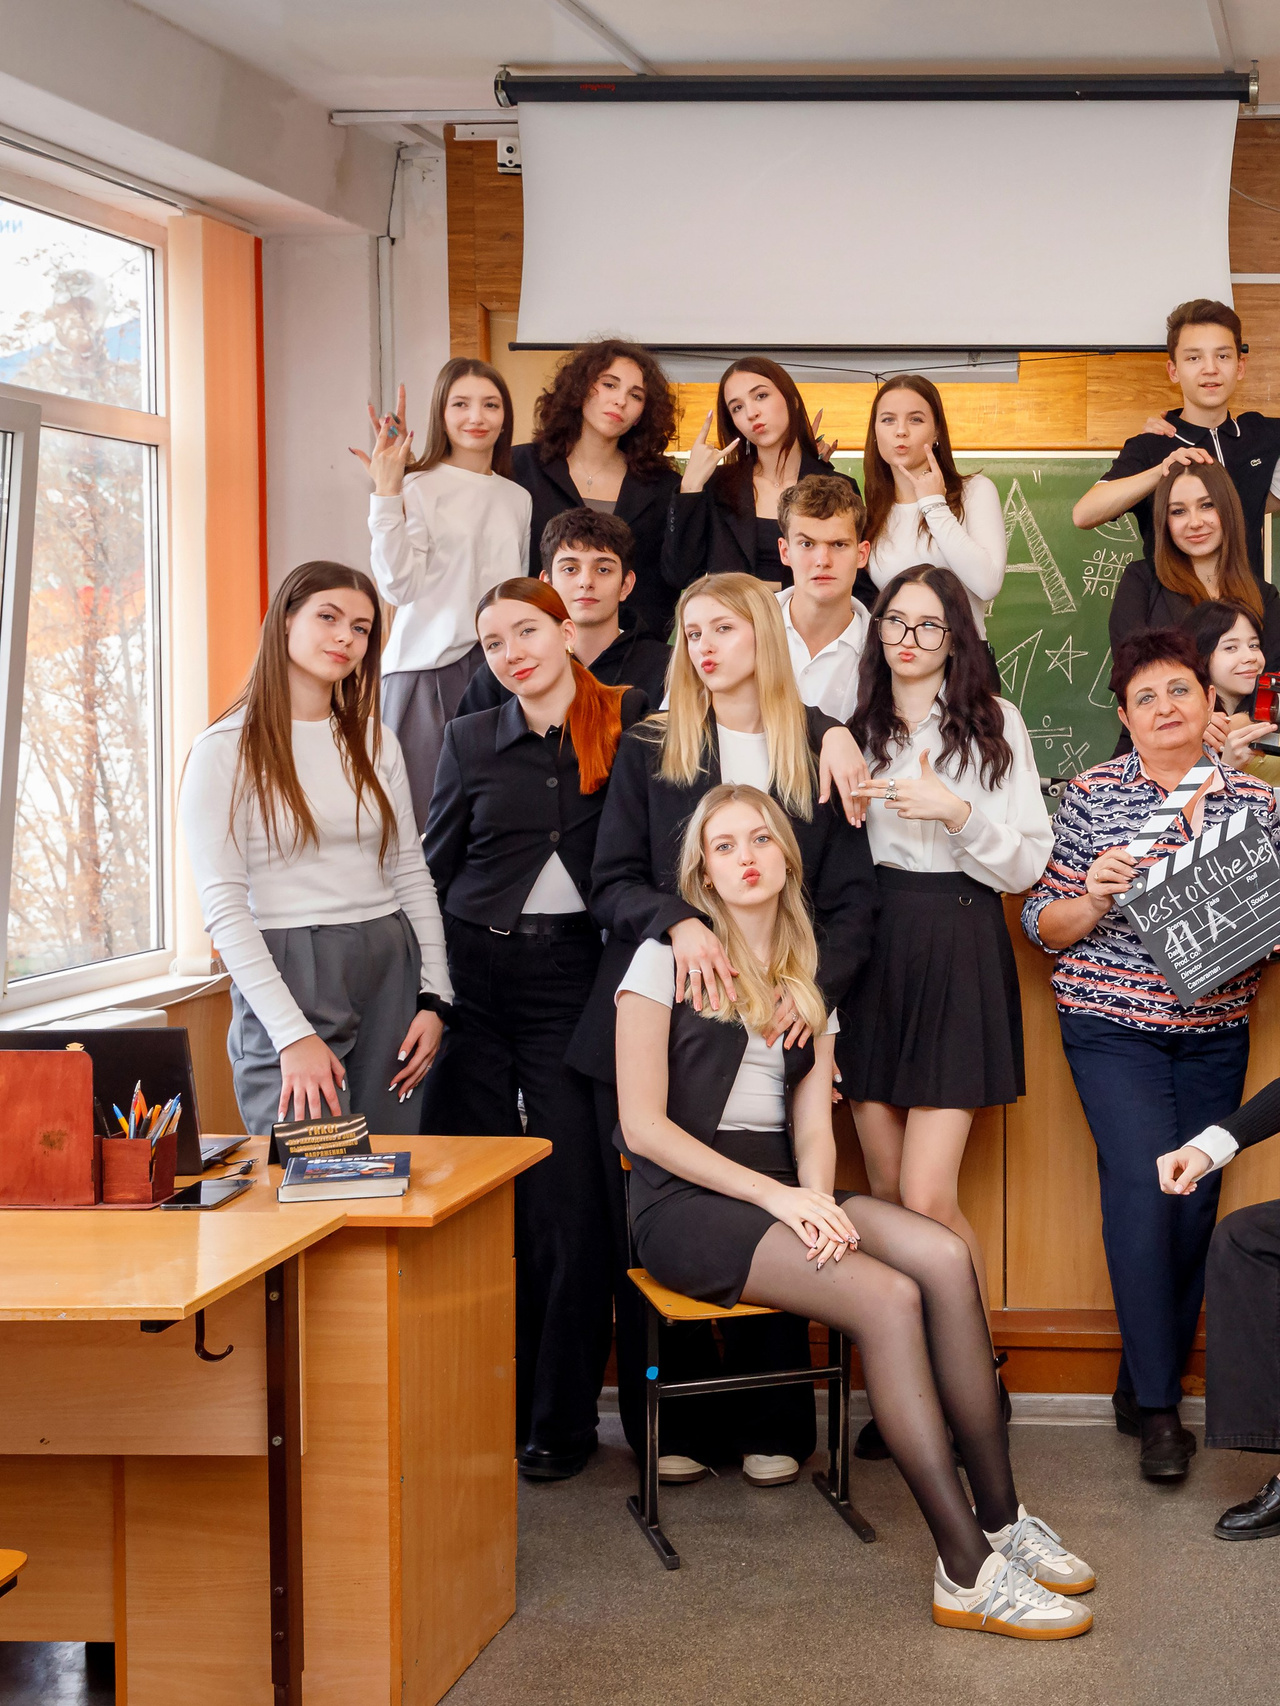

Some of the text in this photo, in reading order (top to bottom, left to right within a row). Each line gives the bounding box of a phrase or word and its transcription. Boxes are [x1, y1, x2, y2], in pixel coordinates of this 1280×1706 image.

[1127, 829, 1280, 933] best of the best
[1246, 871, 1258, 883] Roll
[1205, 897, 1220, 907] Take
[1250, 890, 1269, 906] Sound
[1167, 947, 1181, 960] Dat
[1173, 950, 1201, 970] Prod. Co.
[1180, 962, 1203, 980] Director
[1187, 965, 1221, 990] Cameraman
